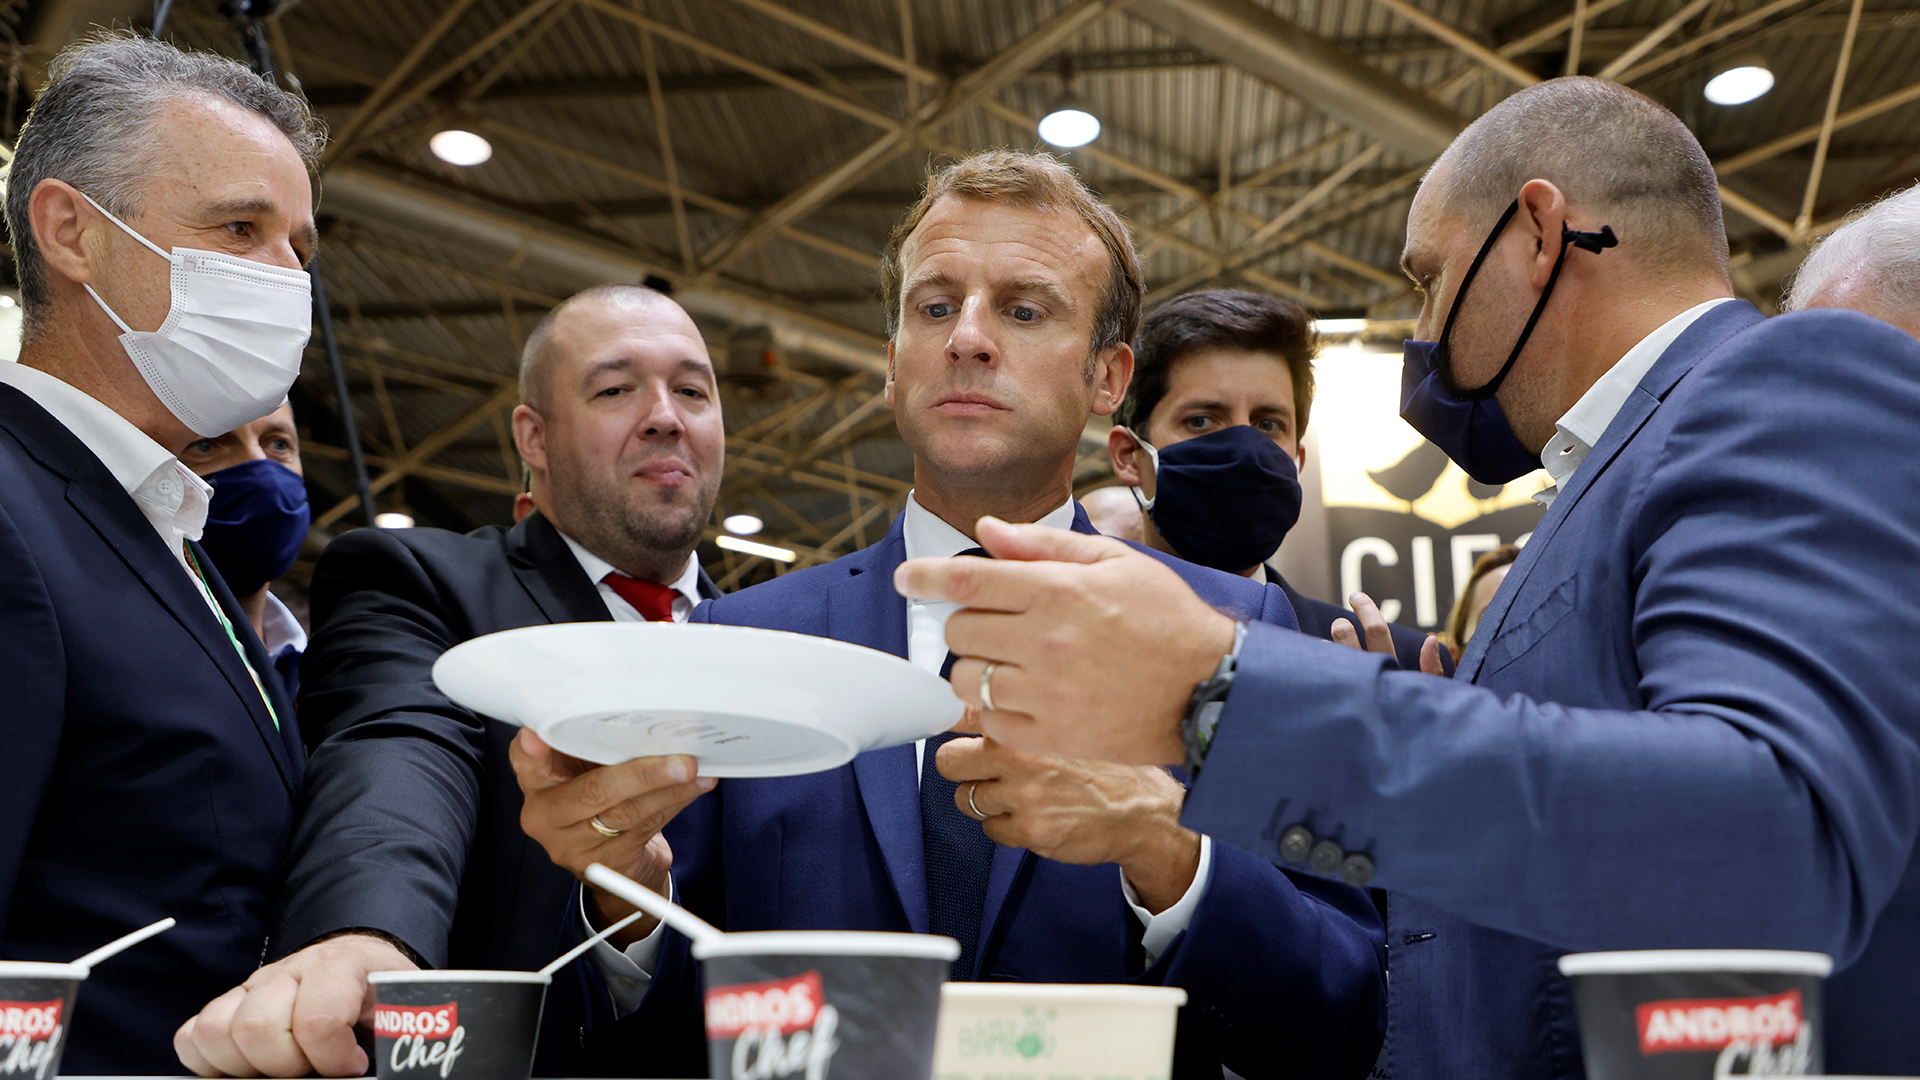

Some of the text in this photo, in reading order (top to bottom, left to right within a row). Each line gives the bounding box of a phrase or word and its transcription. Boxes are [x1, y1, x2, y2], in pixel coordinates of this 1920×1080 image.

[732, 1004, 841, 1080] Chef
[1645, 998, 1797, 1044] ANDROS
[390, 1025, 464, 1079] Chef
